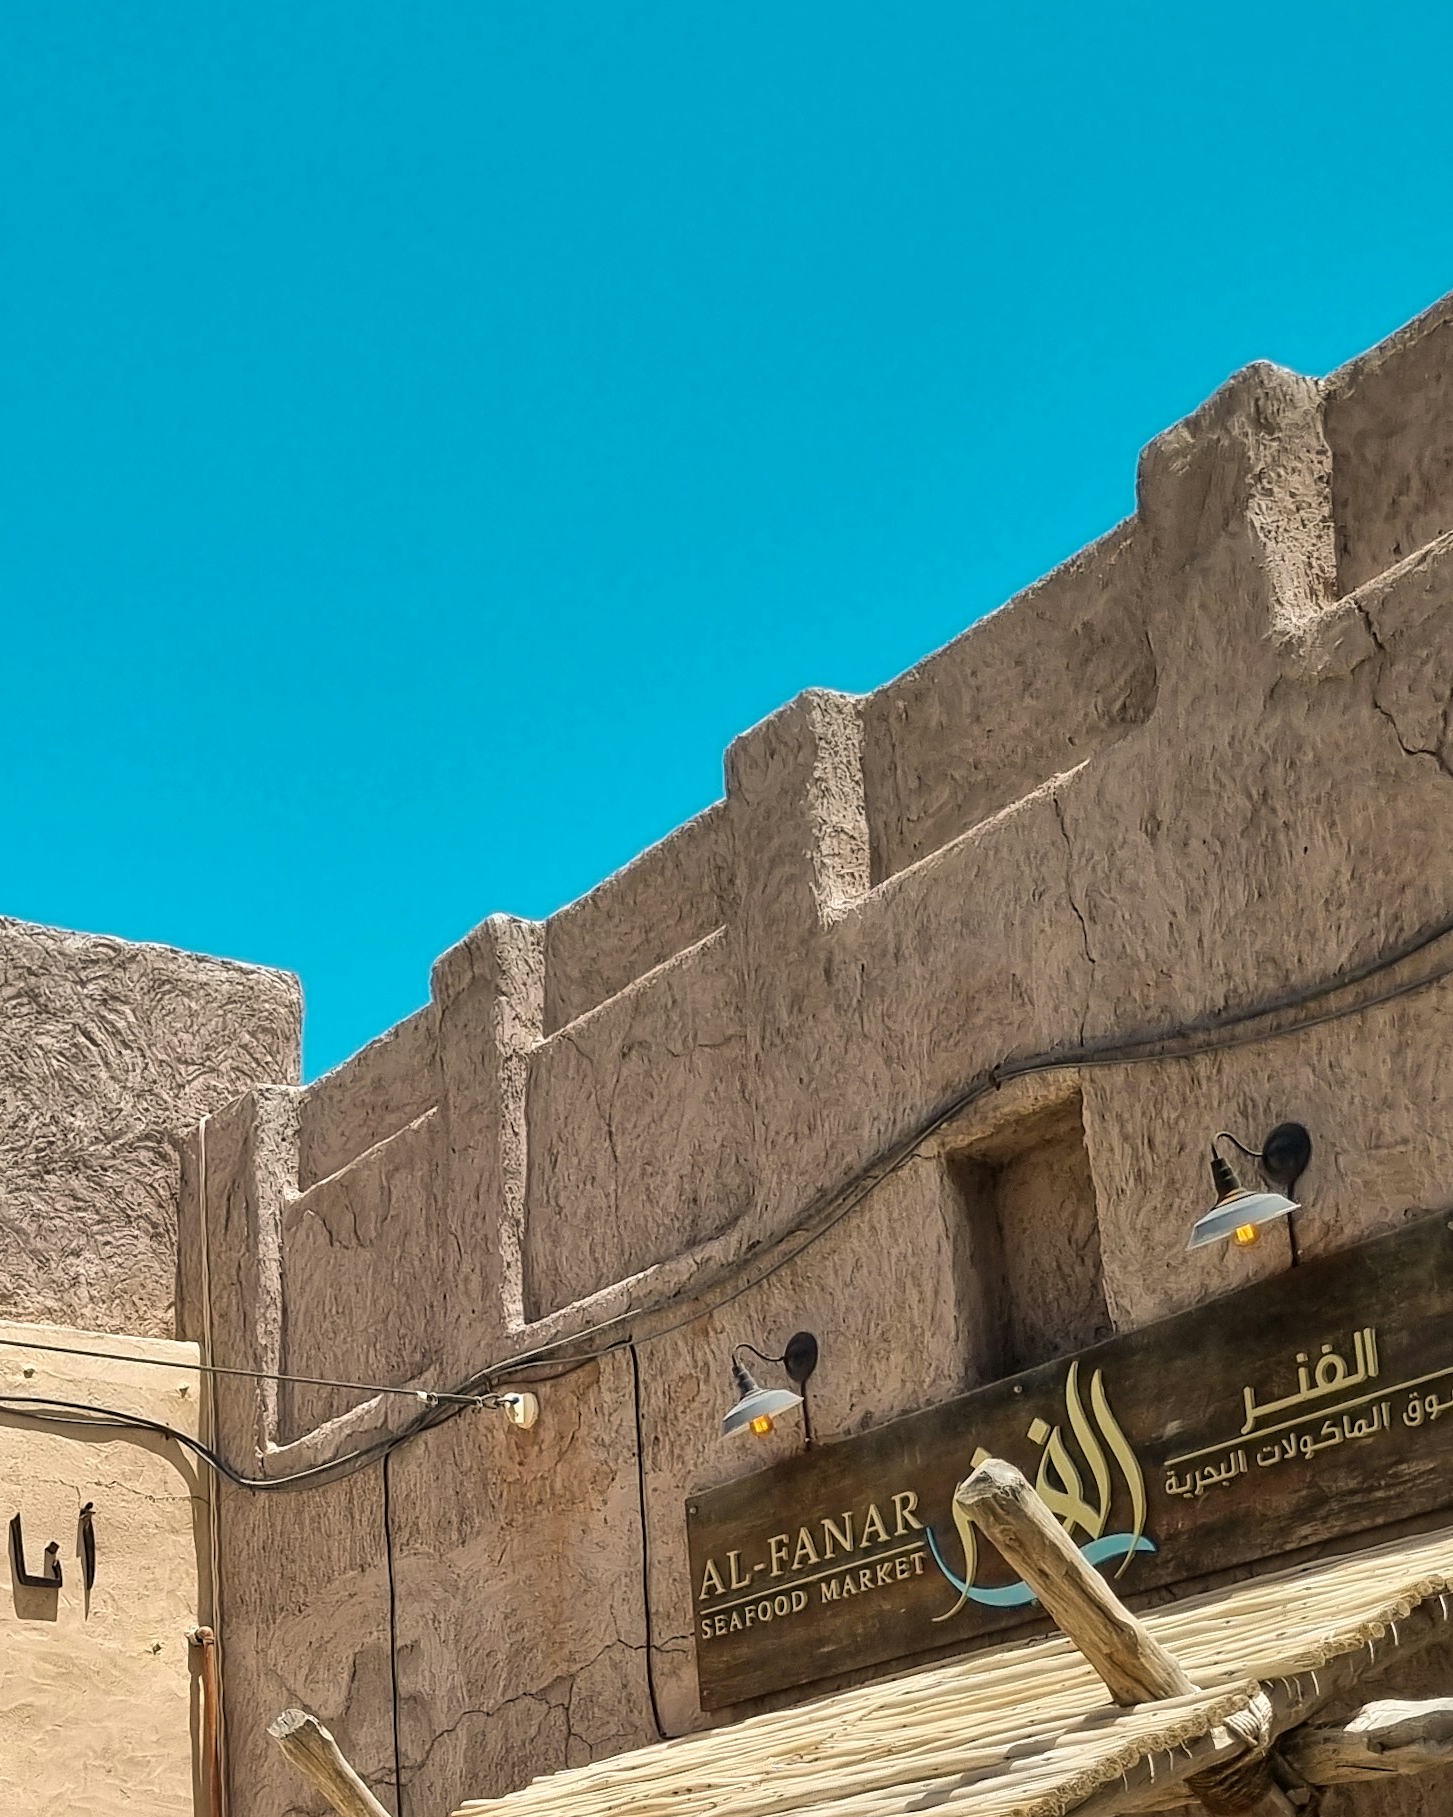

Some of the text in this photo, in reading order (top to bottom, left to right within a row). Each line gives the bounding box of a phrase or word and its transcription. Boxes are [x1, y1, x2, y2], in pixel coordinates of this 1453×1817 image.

[1240, 1327, 1380, 1435] الفنر
[1402, 1389, 1453, 1427] وق
[931, 1360, 1147, 1623] الفر
[1164, 1450, 1248, 1498] البحرية
[698, 1490, 924, 1600] AL-FANAR
[701, 1552, 927, 1640] SEAFOOD MARKET
